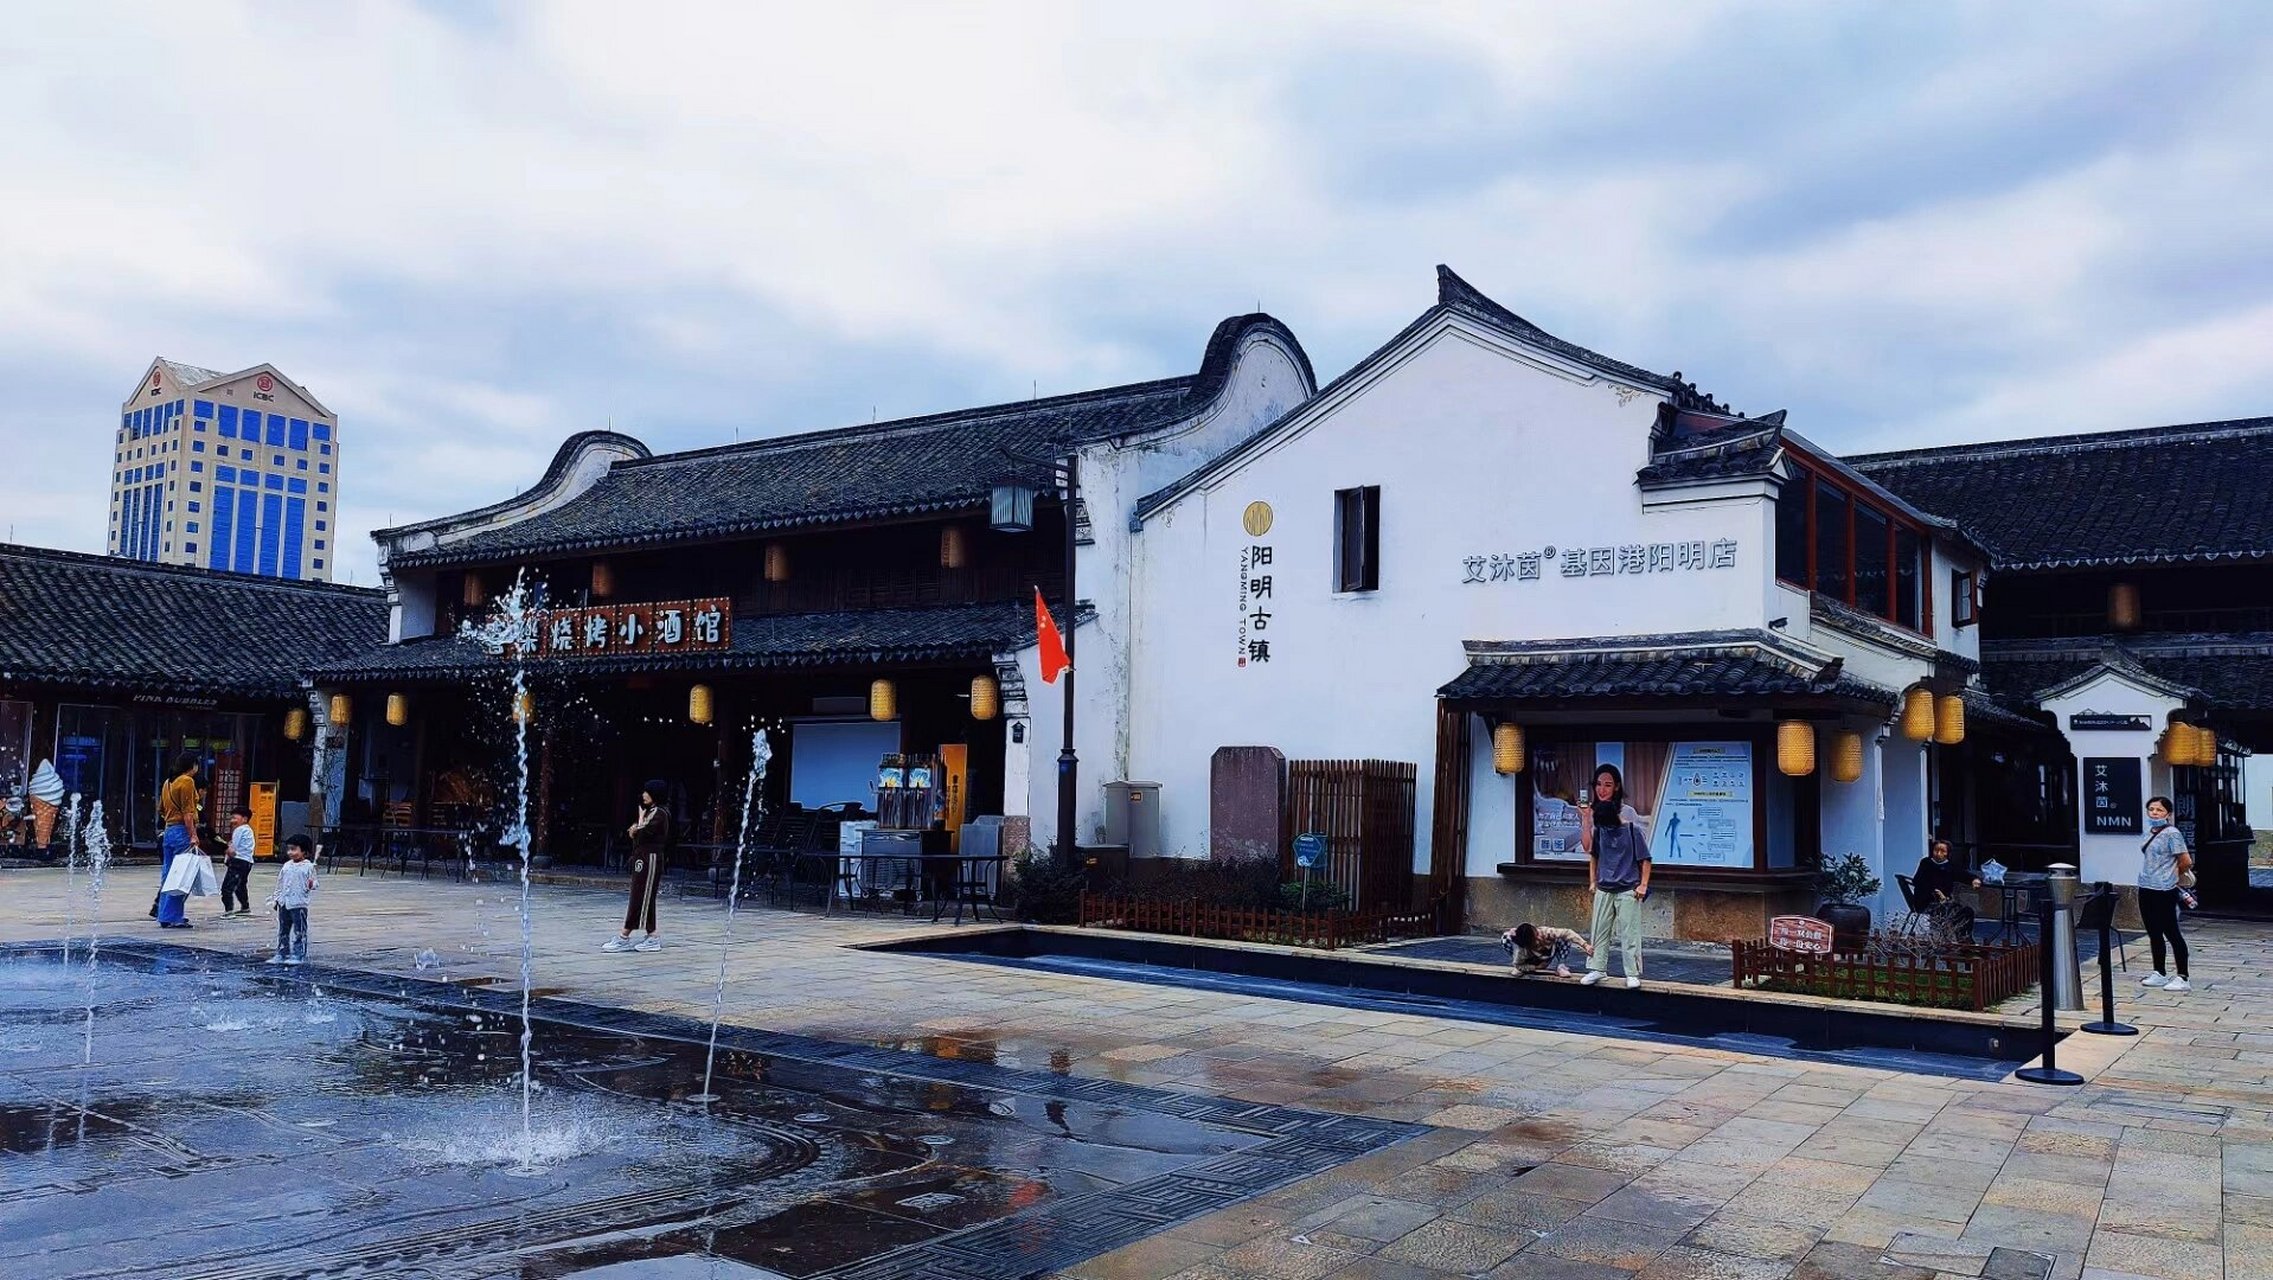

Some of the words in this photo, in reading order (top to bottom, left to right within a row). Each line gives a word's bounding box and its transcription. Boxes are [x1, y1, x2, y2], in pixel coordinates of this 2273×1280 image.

[1239, 547, 1249, 612] YANGMING
[1248, 545, 1273, 663] 阳明古镇
[1238, 618, 1247, 655] TOWN
[2096, 815, 2132, 828] NMN
